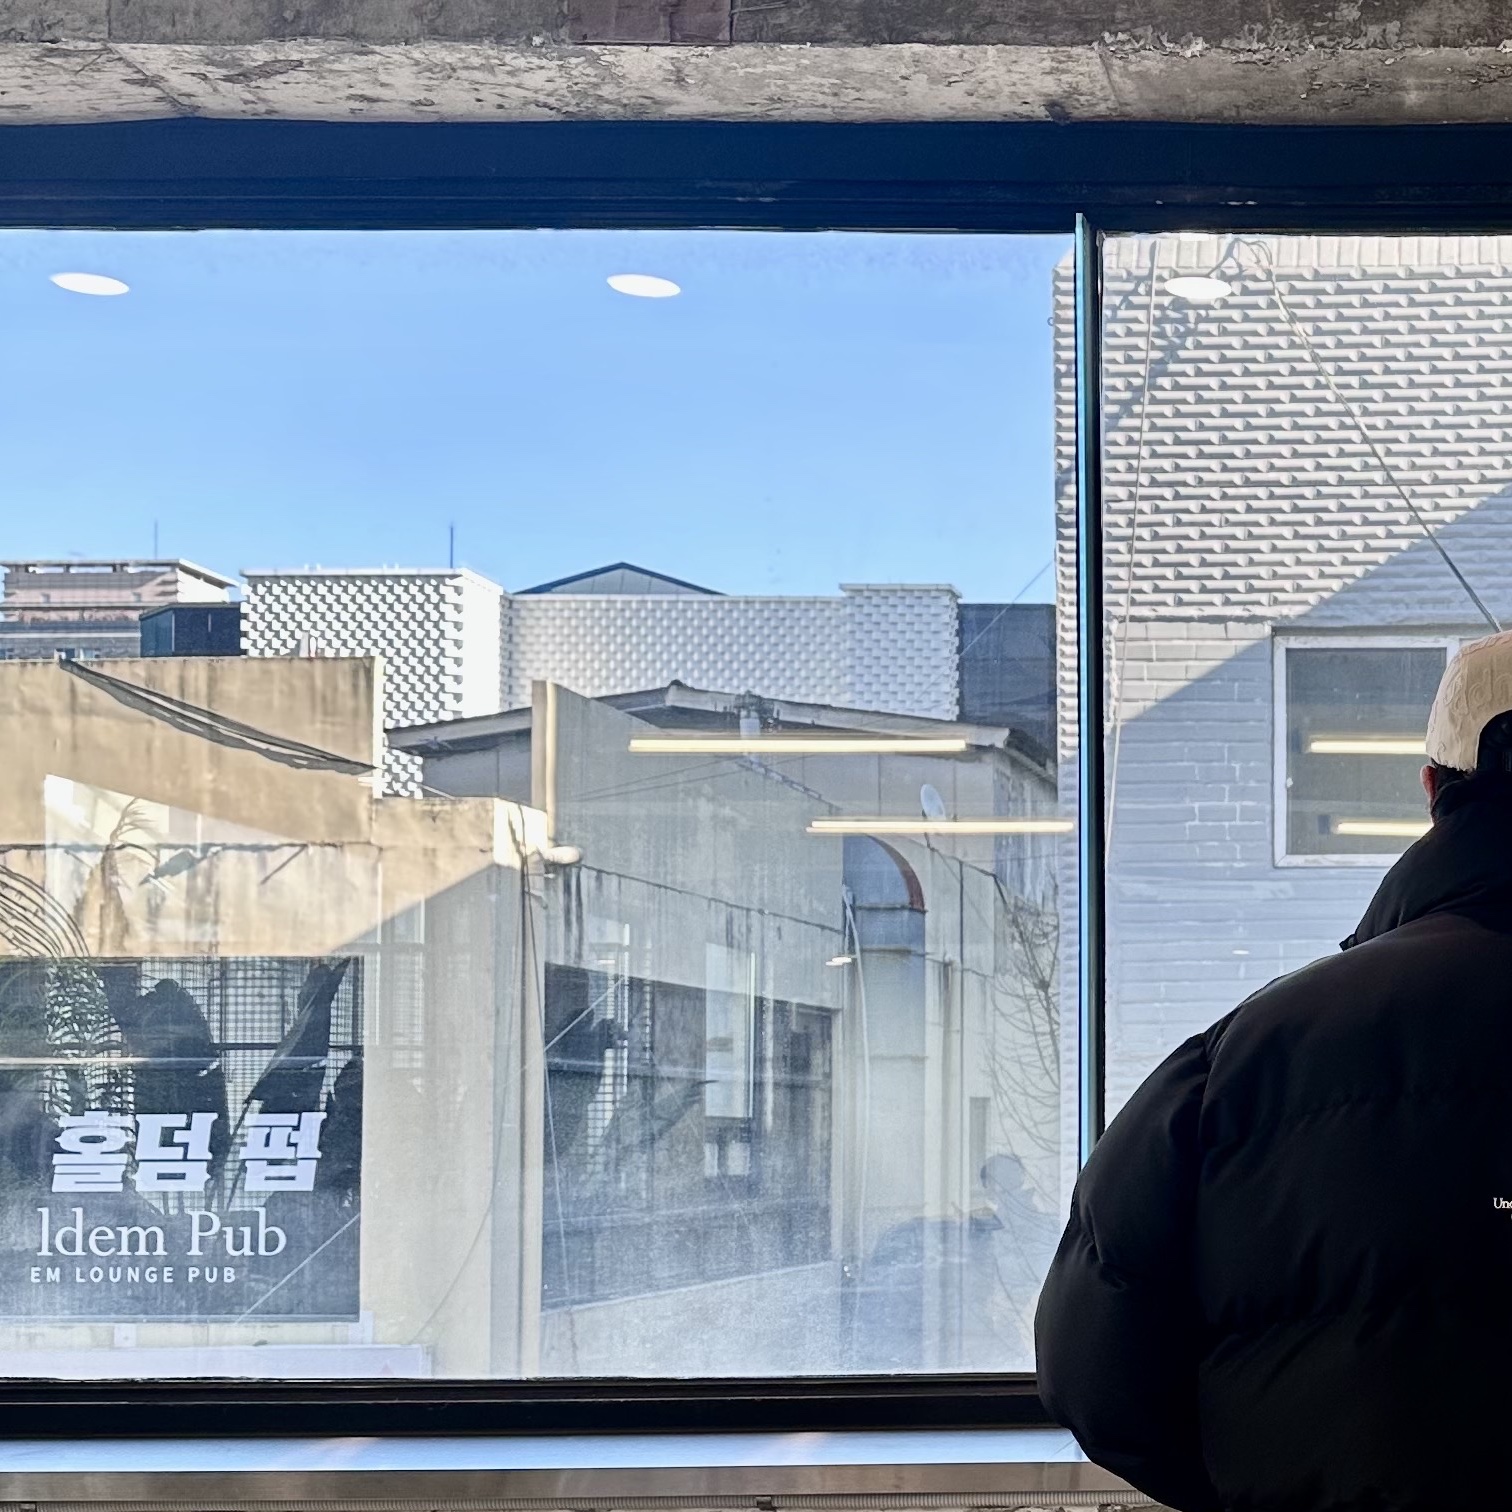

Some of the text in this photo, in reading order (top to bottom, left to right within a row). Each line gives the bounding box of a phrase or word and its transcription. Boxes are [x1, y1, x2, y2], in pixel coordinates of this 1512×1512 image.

[52, 1110, 327, 1192] 홀덤 펍
[186, 1207, 287, 1257] Pub
[30, 1266, 236, 1284] EM LOUNGE PUB
